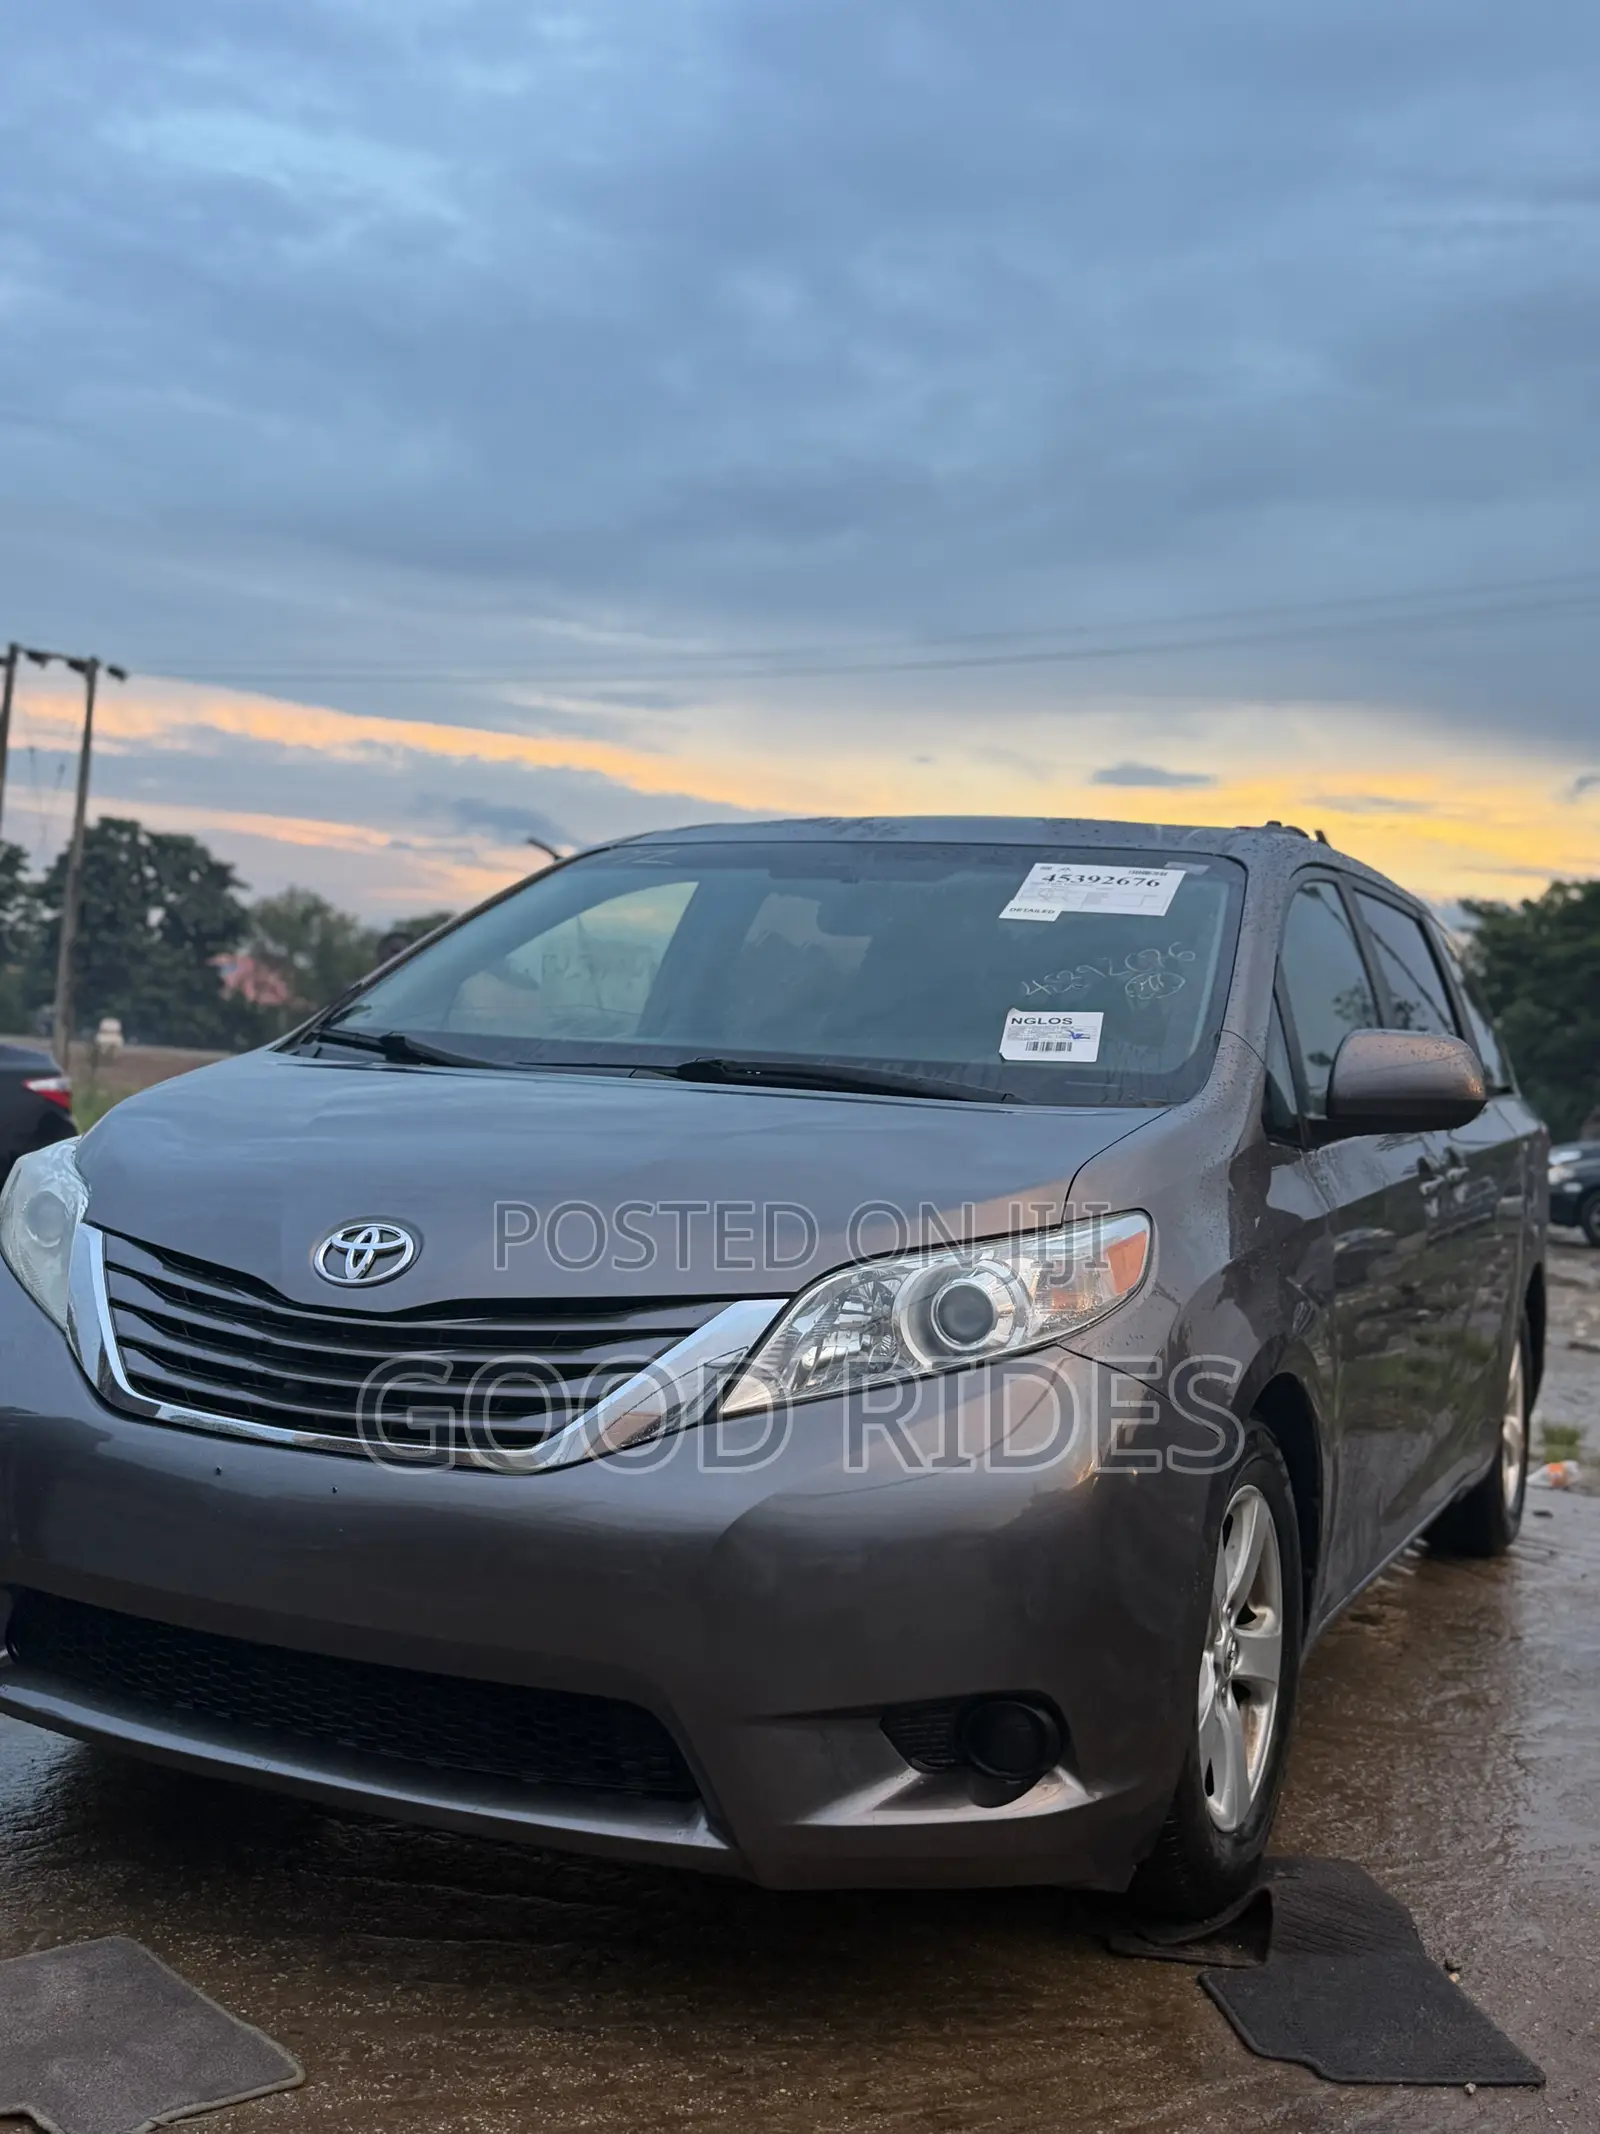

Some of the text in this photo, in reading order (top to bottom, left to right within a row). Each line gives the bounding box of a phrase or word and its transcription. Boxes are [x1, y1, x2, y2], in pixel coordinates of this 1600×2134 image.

[1042, 874, 1160, 887] 45392676
[1009, 907, 1055, 915] DETAILED
[1011, 1017, 1073, 1025] NGLOS
